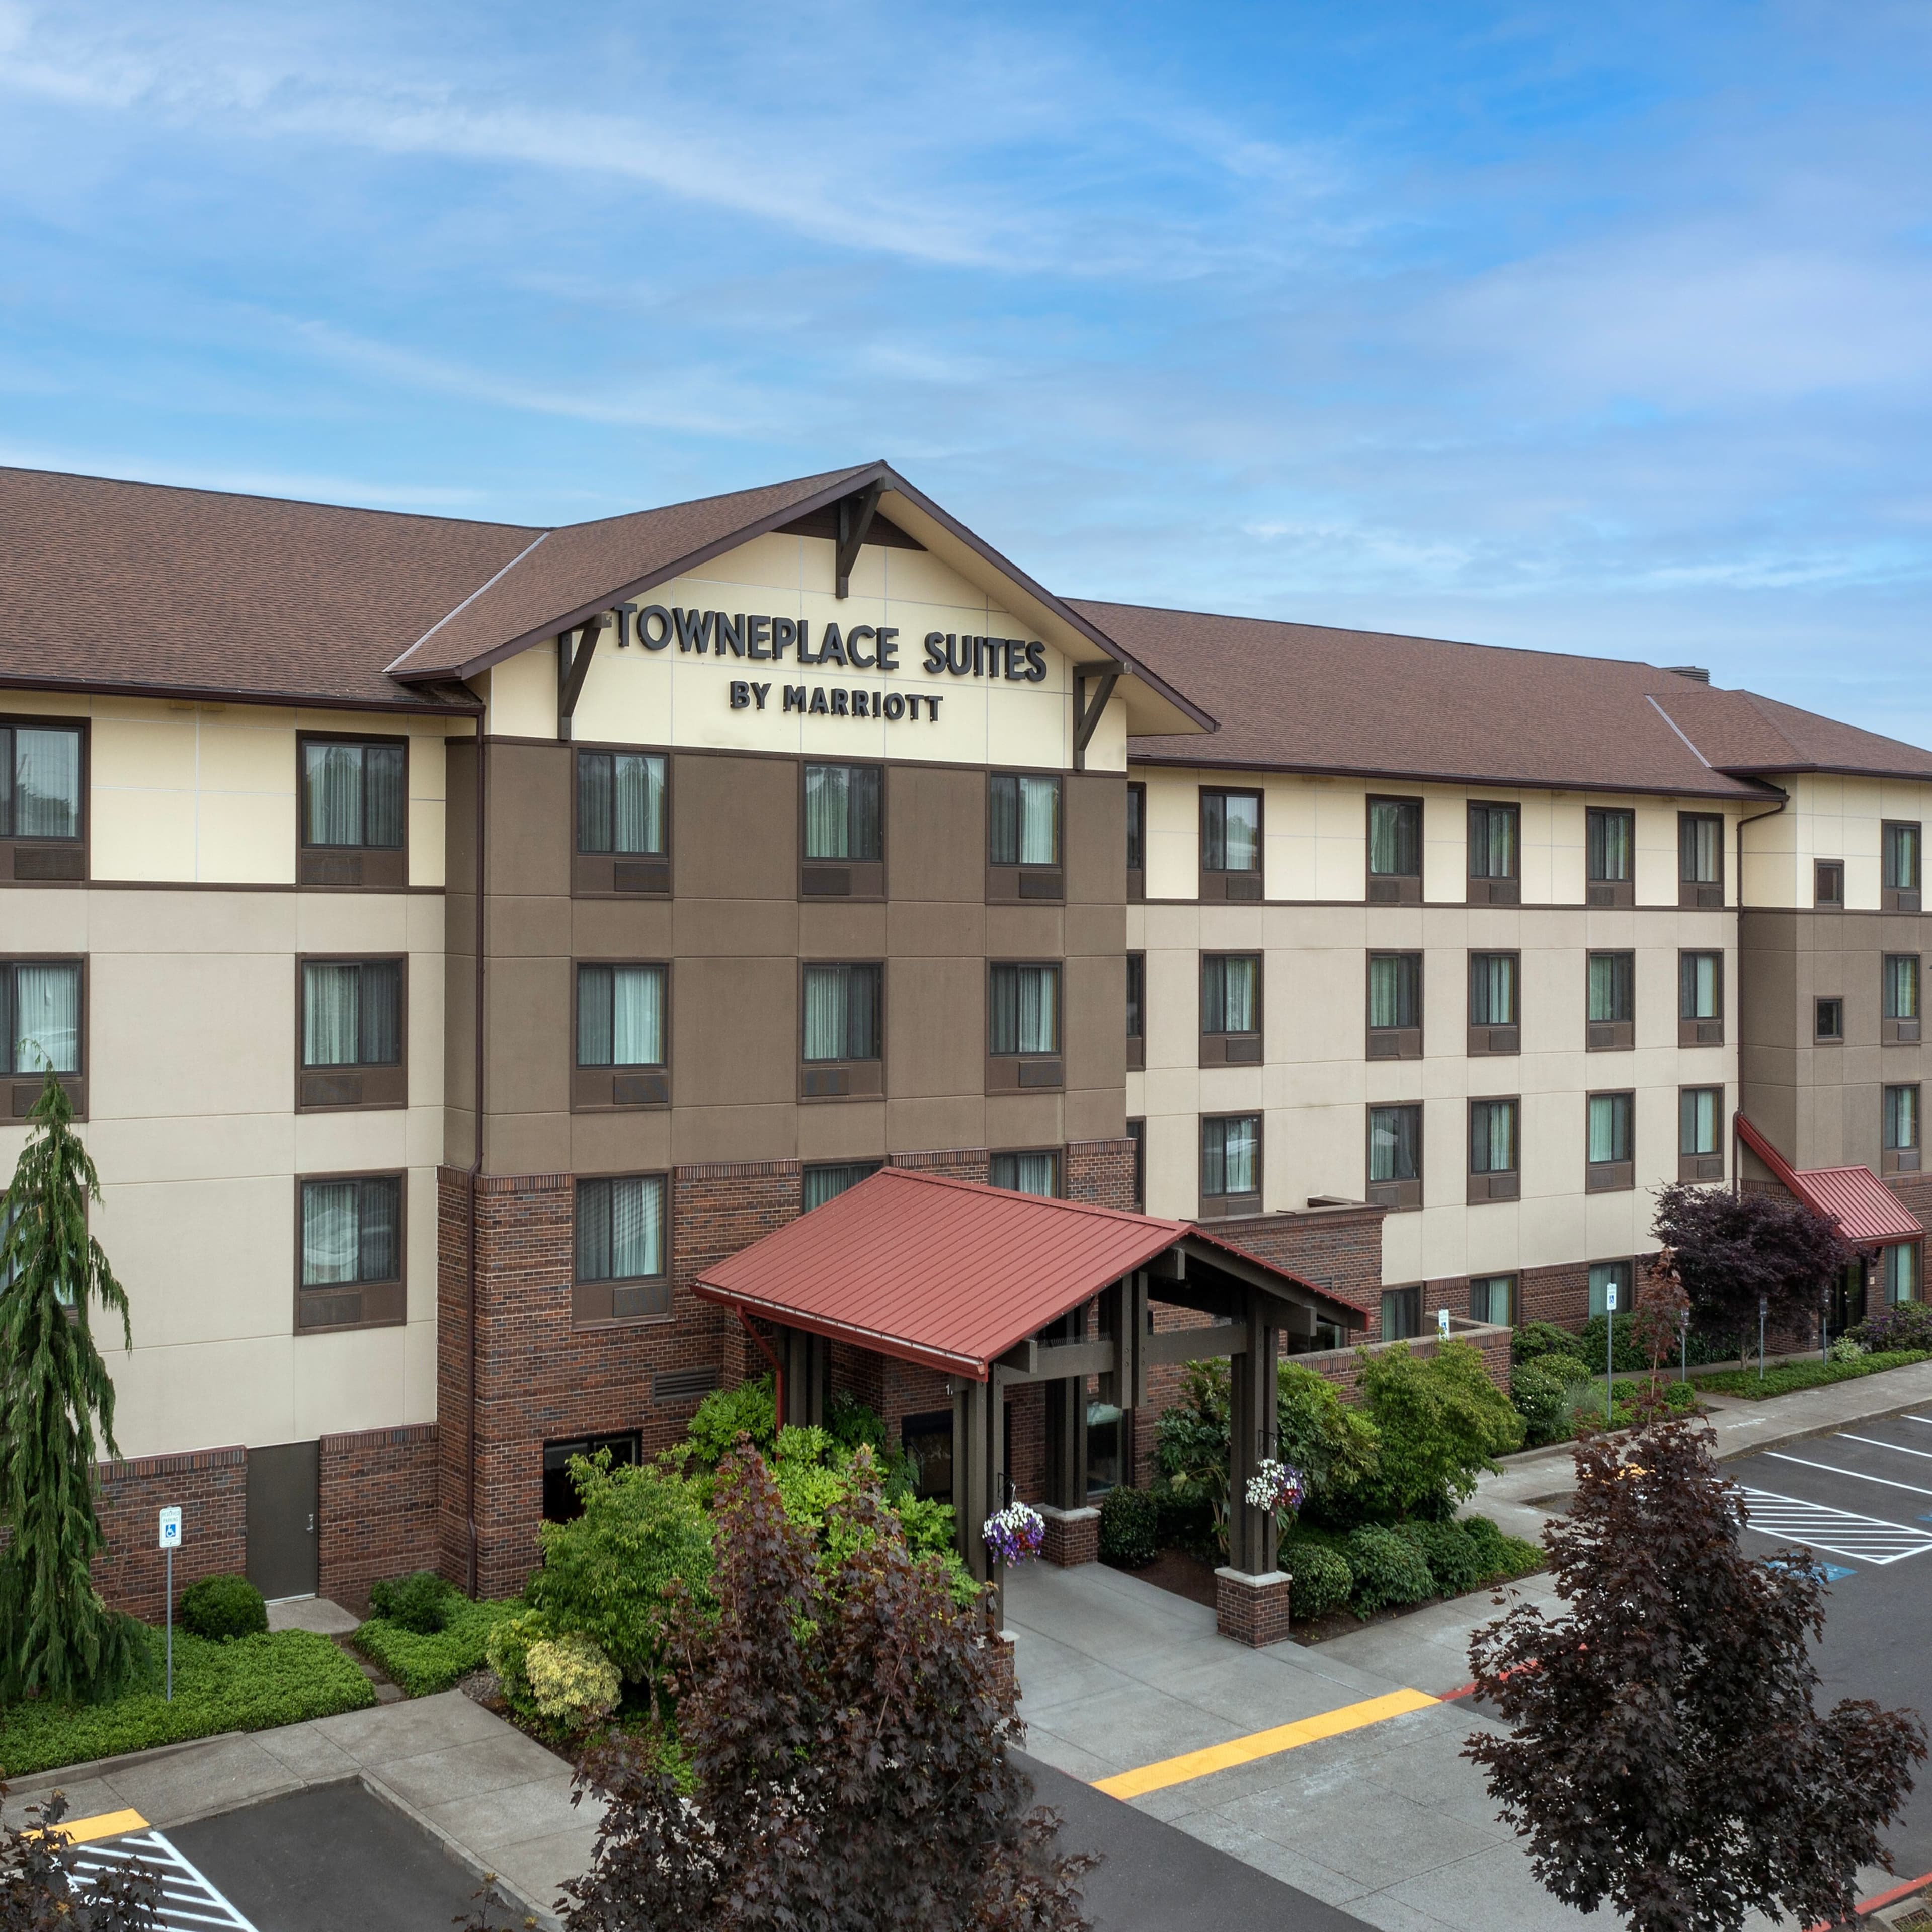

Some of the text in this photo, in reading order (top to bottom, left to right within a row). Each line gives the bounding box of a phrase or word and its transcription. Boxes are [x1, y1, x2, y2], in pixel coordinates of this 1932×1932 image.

[611, 602, 1047, 683] TOWNEPLACE SUITES
[730, 681, 944, 722] BY MARRIOTT
